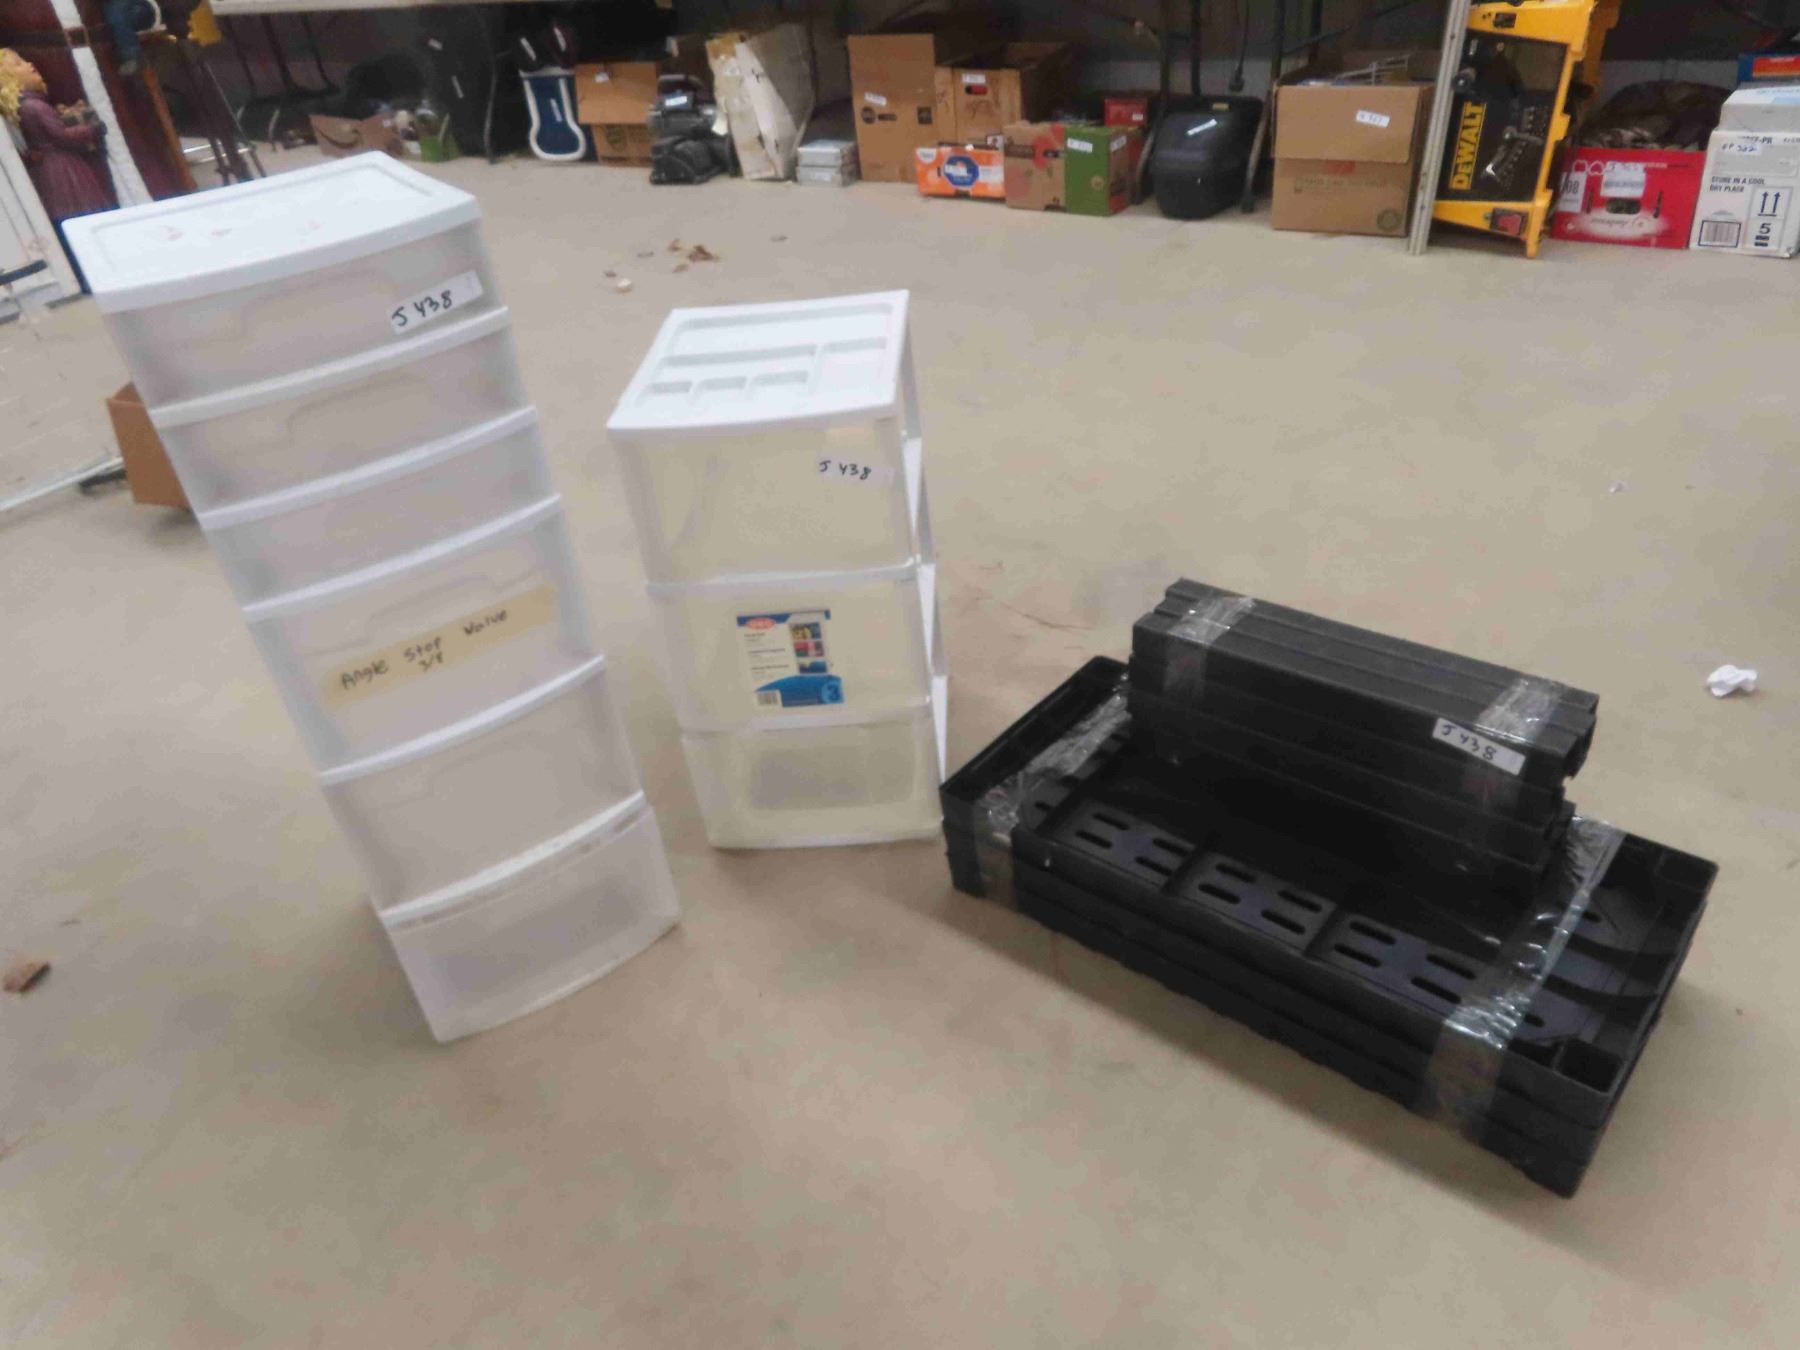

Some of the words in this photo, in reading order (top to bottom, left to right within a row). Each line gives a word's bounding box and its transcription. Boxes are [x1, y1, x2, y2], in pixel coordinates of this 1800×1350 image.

[1452, 101, 1484, 190] DEWALT
[1759, 222, 1772, 234] 5
[413, 289, 452, 317] 438
[839, 463, 872, 480] 438
[341, 660, 389, 689] Angle
[463, 610, 508, 636] Valve
[1460, 733, 1497, 760] 438
